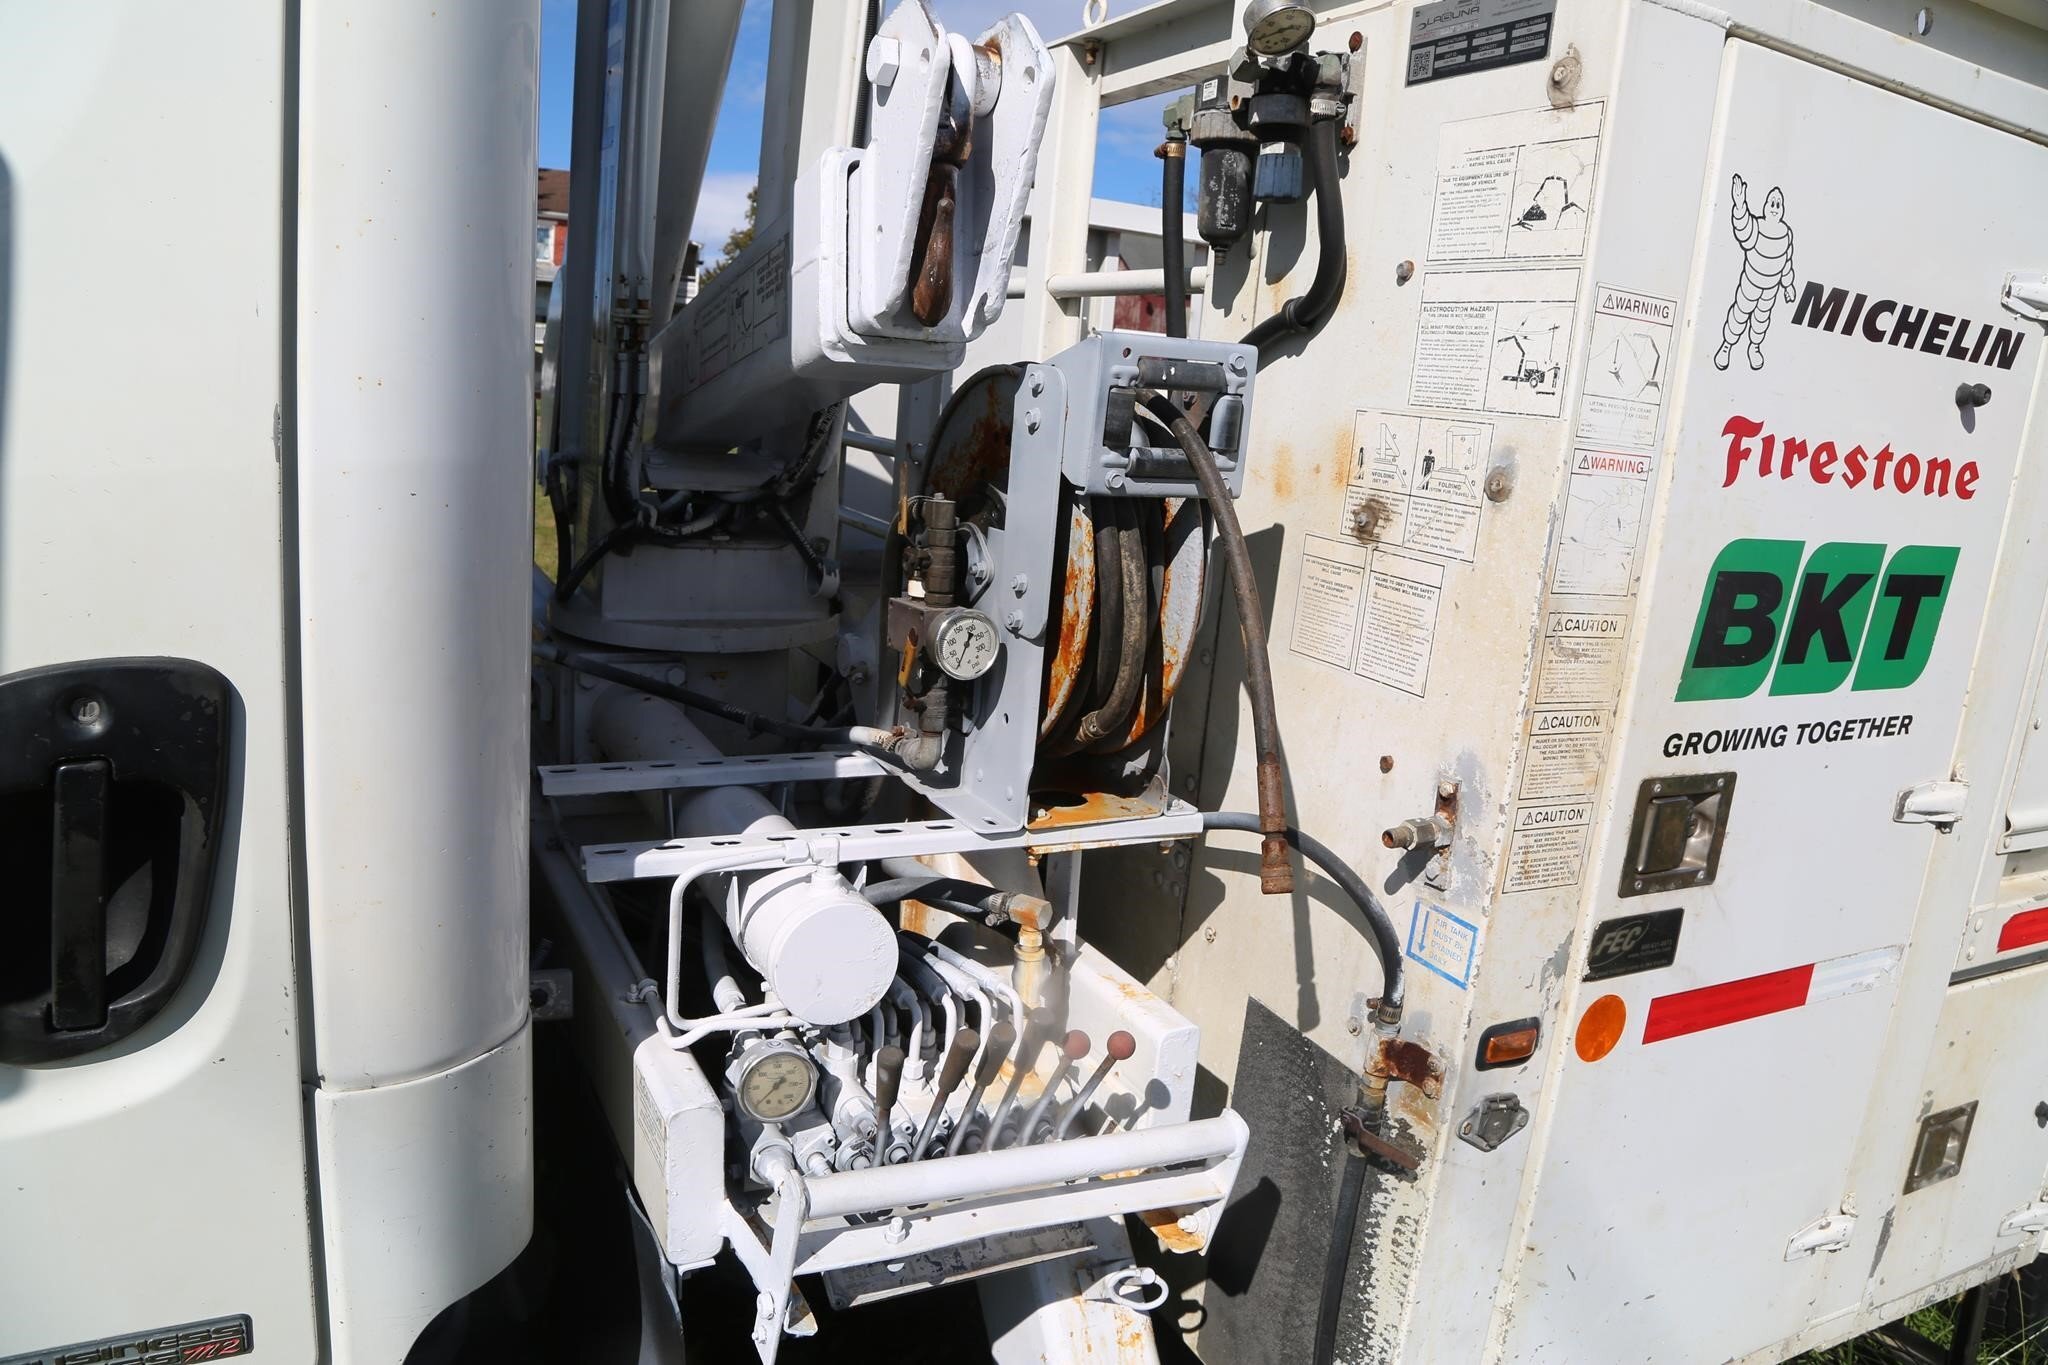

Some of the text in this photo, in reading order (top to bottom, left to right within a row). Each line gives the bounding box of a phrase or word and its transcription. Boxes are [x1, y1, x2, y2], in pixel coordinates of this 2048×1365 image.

[1615, 295, 1670, 319] WARNING
[1791, 281, 2025, 370] MICHELIN
[1590, 456, 1645, 474] WARNING
[1721, 416, 1980, 500] Firestone
[1564, 619, 1618, 632] CAUTION
[1692, 570, 1946, 669] BKT
[954, 625, 963, 634] 150
[974, 632, 985, 641] 250
[946, 638, 957, 646] 100
[1550, 715, 1601, 729] CAUTION
[1662, 714, 1914, 758] GROWING TOGETHER
[1534, 808, 1585, 824] CAUTION
[1432, 928, 1453, 945] MUST
[1450, 925, 1469, 941] TANK
[1595, 926, 1642, 956] FEC
